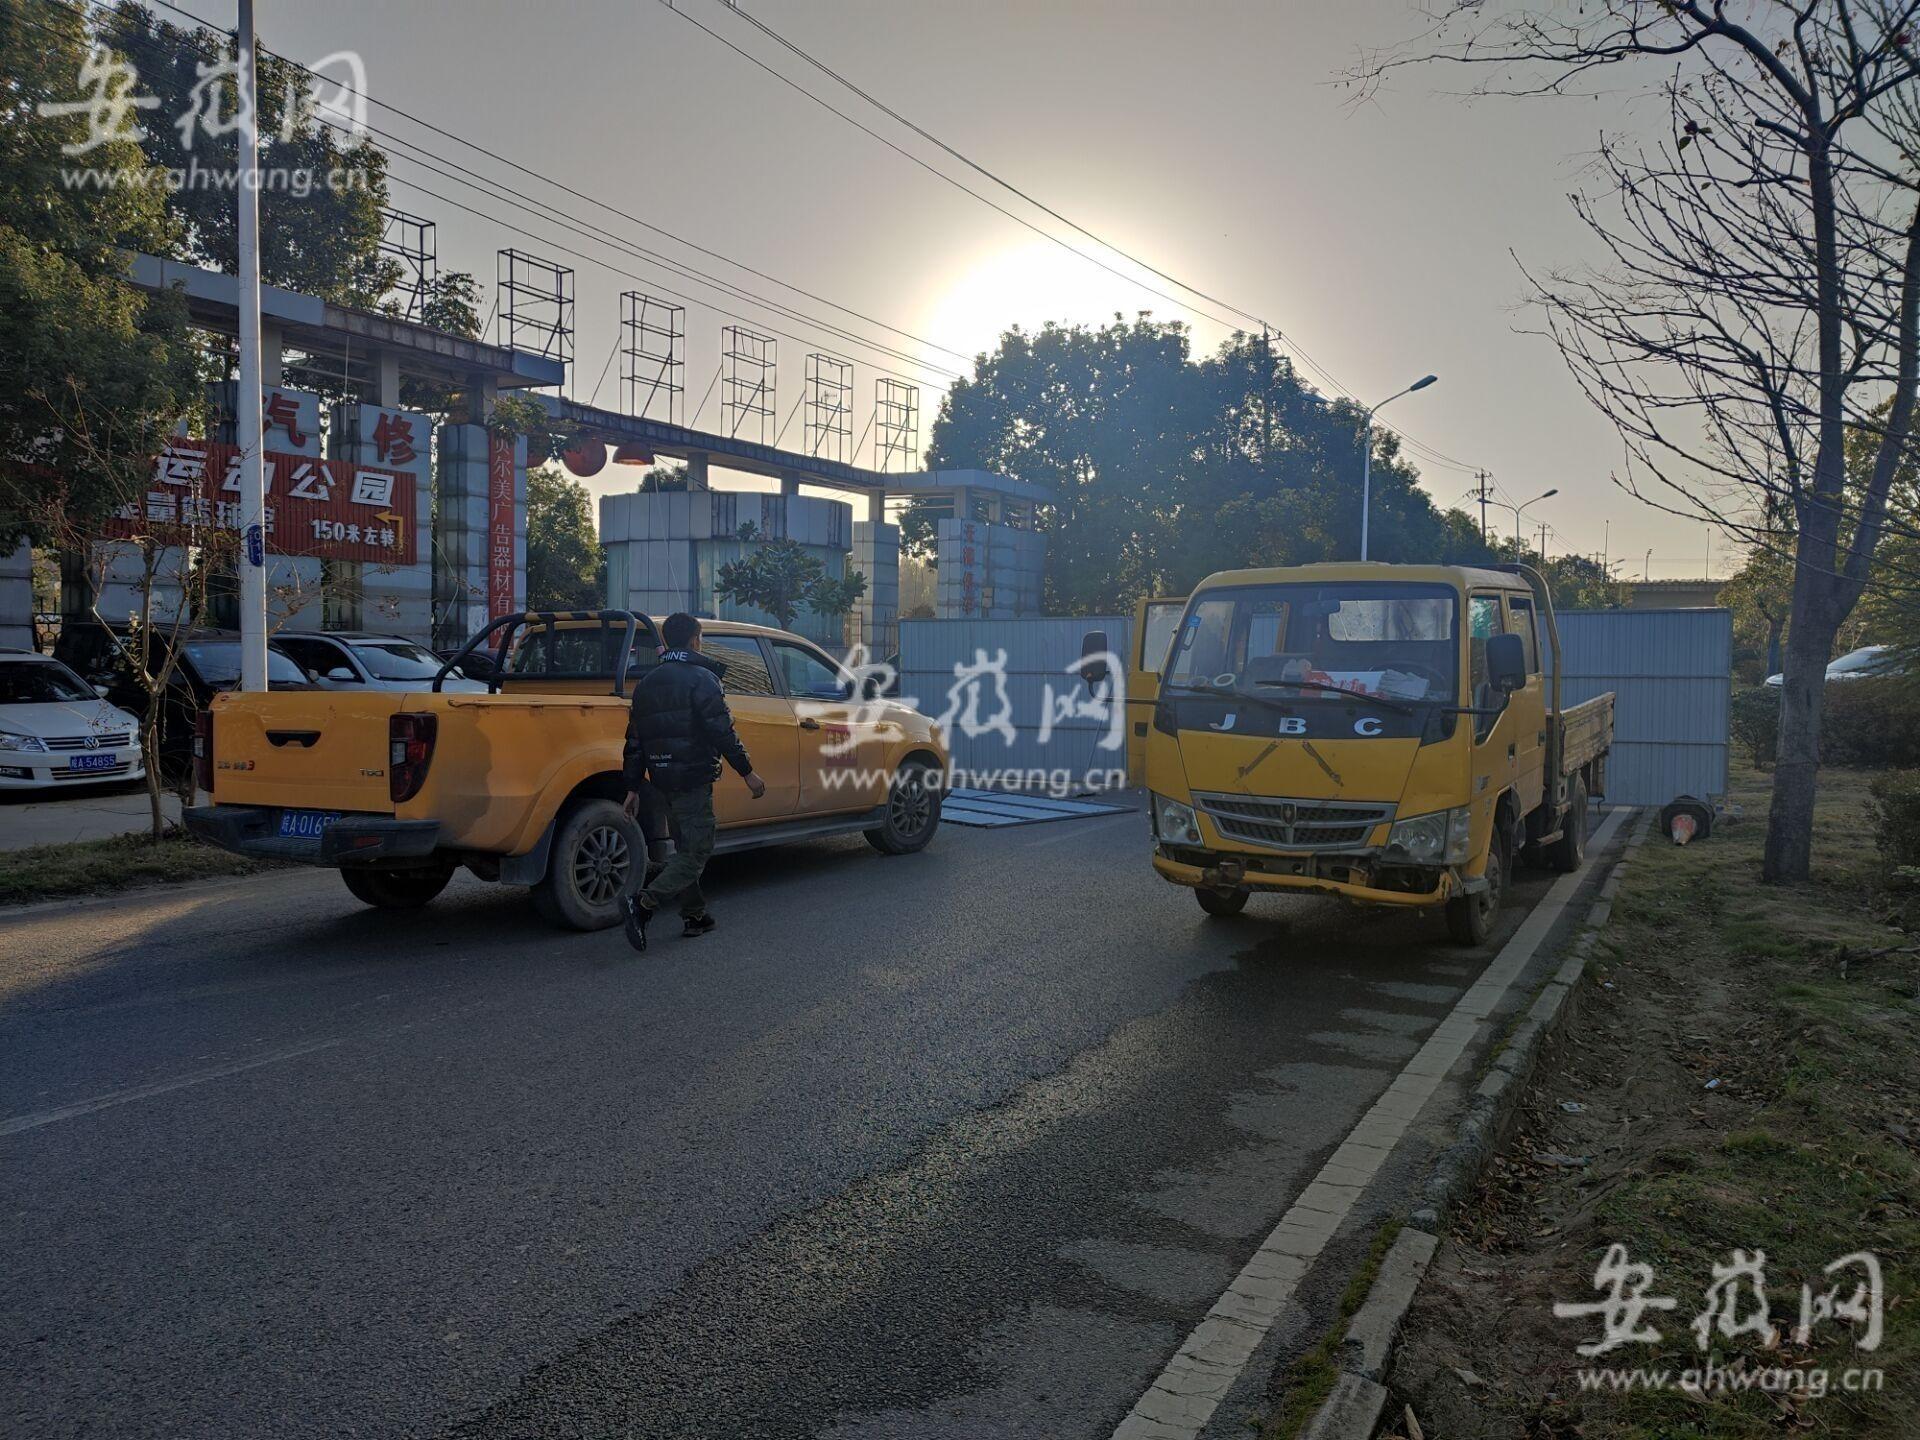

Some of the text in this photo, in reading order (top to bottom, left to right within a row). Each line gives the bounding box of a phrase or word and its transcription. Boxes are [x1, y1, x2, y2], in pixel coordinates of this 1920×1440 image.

[153, 448, 394, 508] 运动公园
[311, 518, 395, 547] 150米左转
